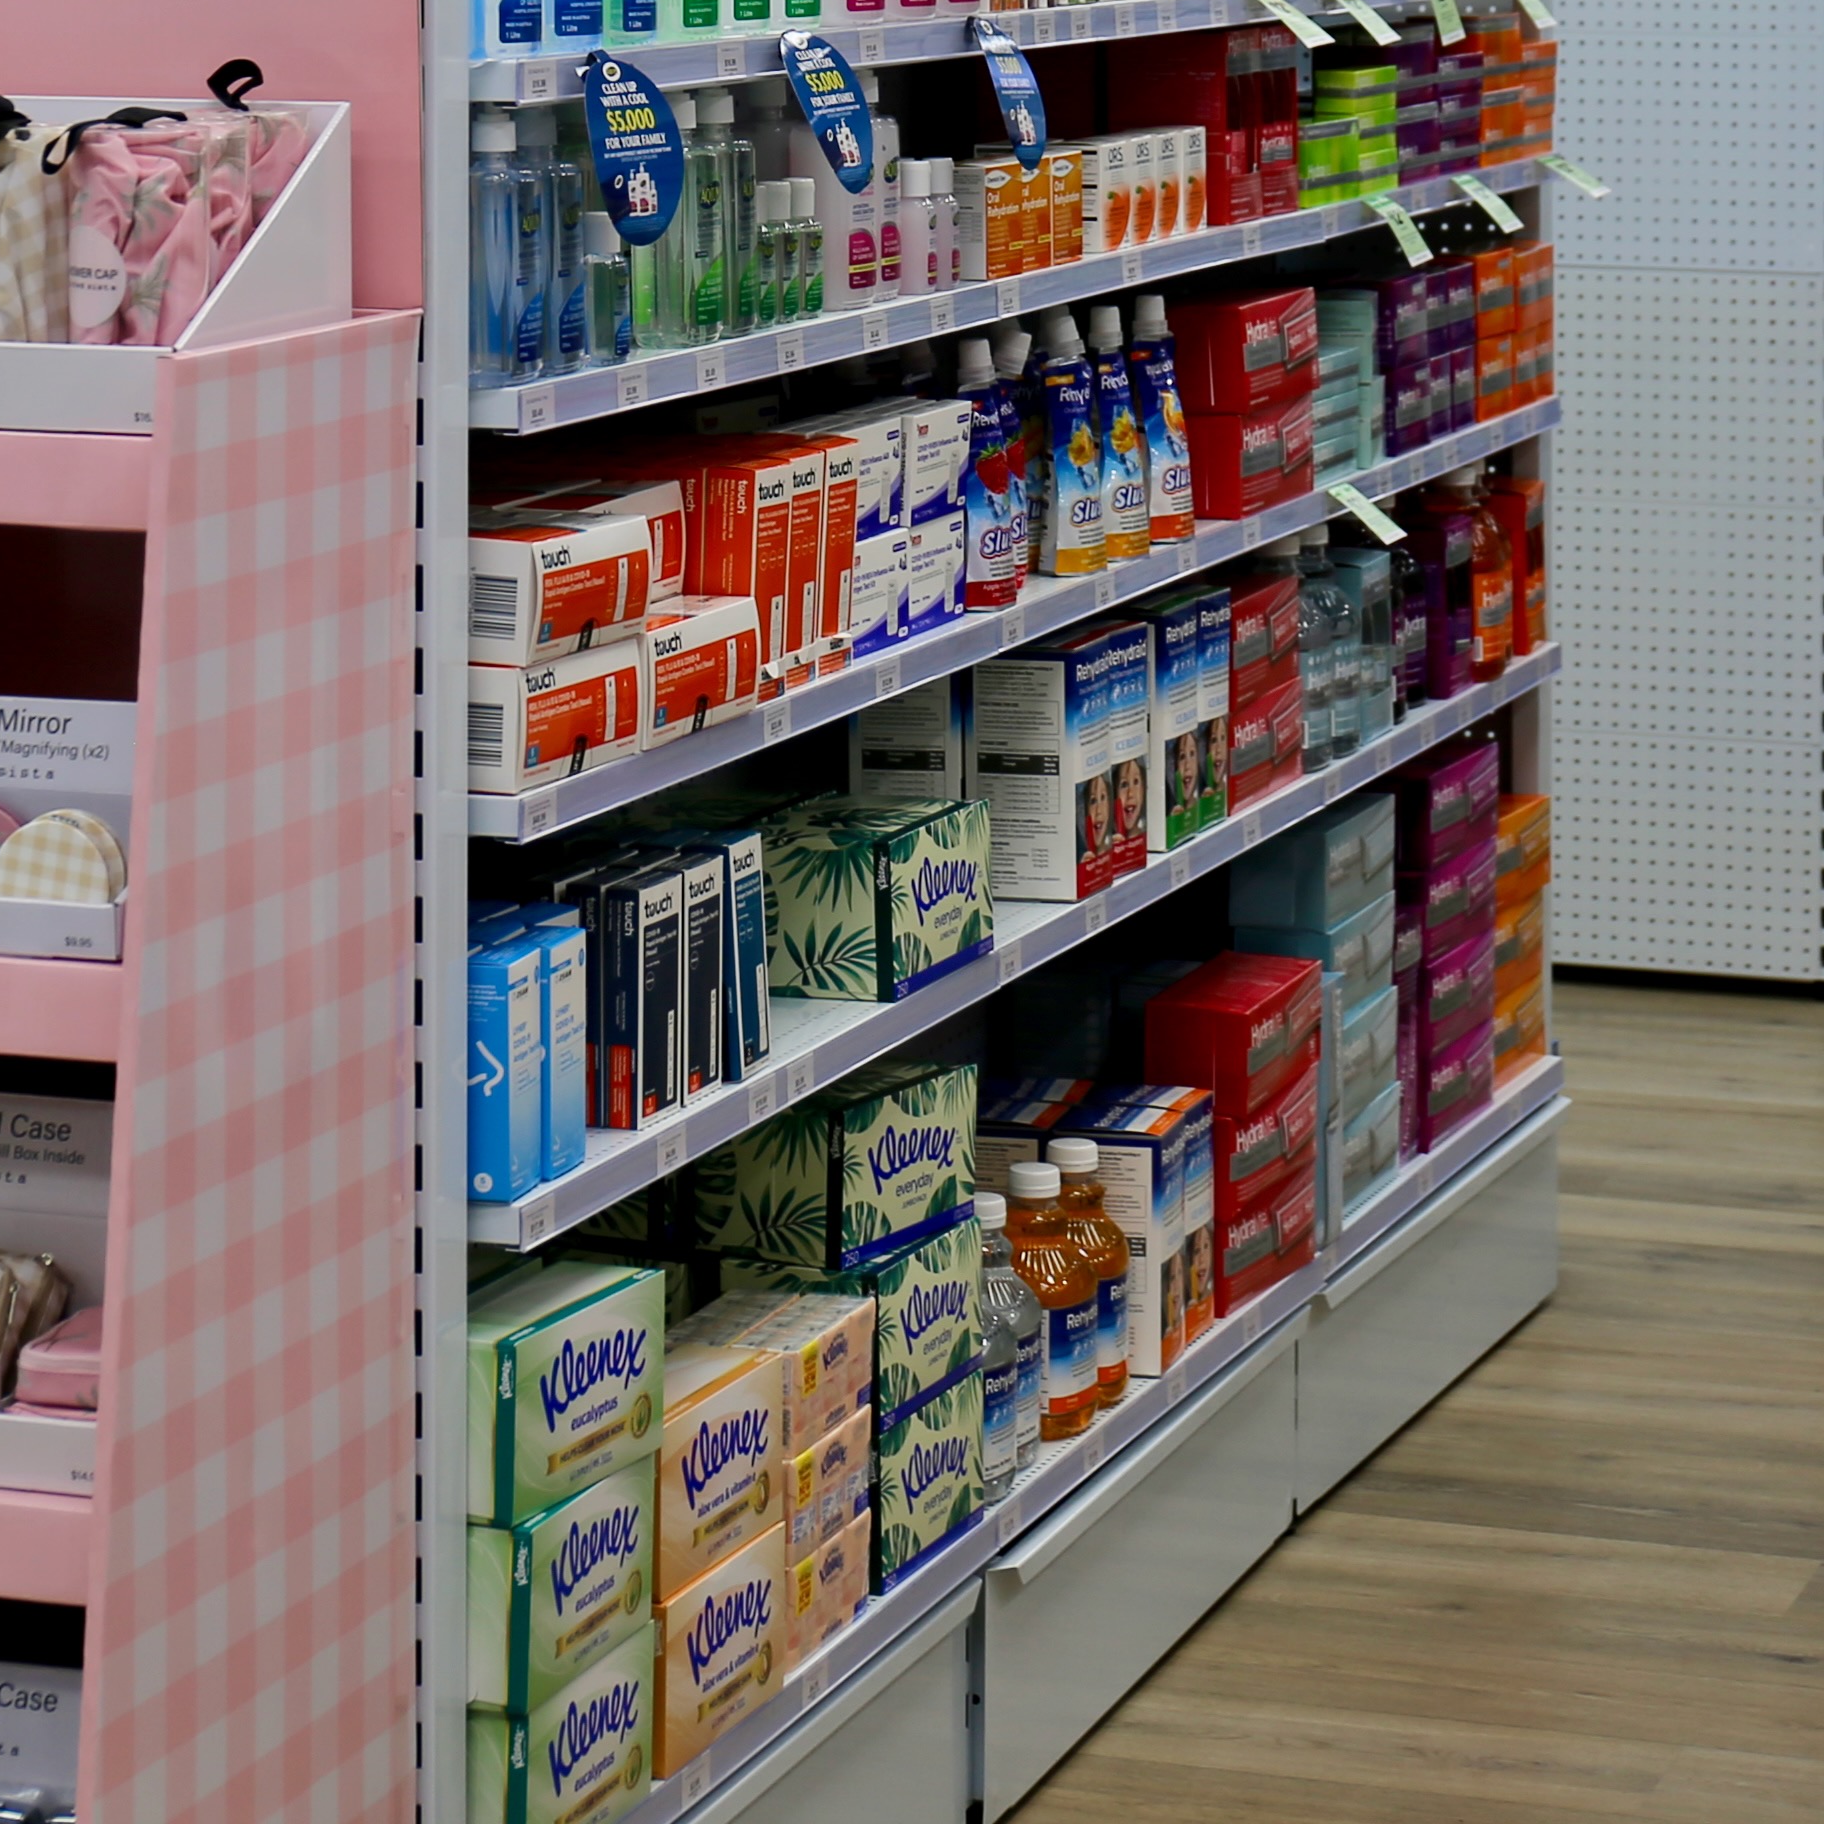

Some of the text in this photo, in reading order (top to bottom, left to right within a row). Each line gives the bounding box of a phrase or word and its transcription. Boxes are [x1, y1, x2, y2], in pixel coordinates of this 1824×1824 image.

[601, 81, 637, 94] CLEAN UP
[805, 70, 844, 95] $5,000
[600, 95, 622, 107] WITH
[628, 93, 649, 105] COOL
[606, 107, 655, 135] $5,000
[605, 133, 666, 150] FOR YOUR FAMILY
[541, 545, 570, 570] touch
[654, 632, 682, 657] touch
[526, 668, 555, 693] touch
[82, 744, 110, 762] (x2)
[911, 855, 978, 927] Kleenex
[933, 903, 964, 930] everyday
[896, 983, 909, 998] 250
[9, 1113, 72, 1142] Case
[13, 1144, 39, 1160] Box
[42, 1146, 85, 1165] Inside
[868, 1124, 957, 1195] Kleenex
[896, 1172, 935, 1198] everyday
[539, 1328, 647, 1433] Kleenex
[570, 1395, 620, 1432] eucalyptus
[550, 1503, 639, 1617] Kleenex
[575, 1573, 616, 1613] eucalyptus
[547, 1680, 639, 1798] Kleenex
[574, 1749, 616, 1793] eucalyptus
